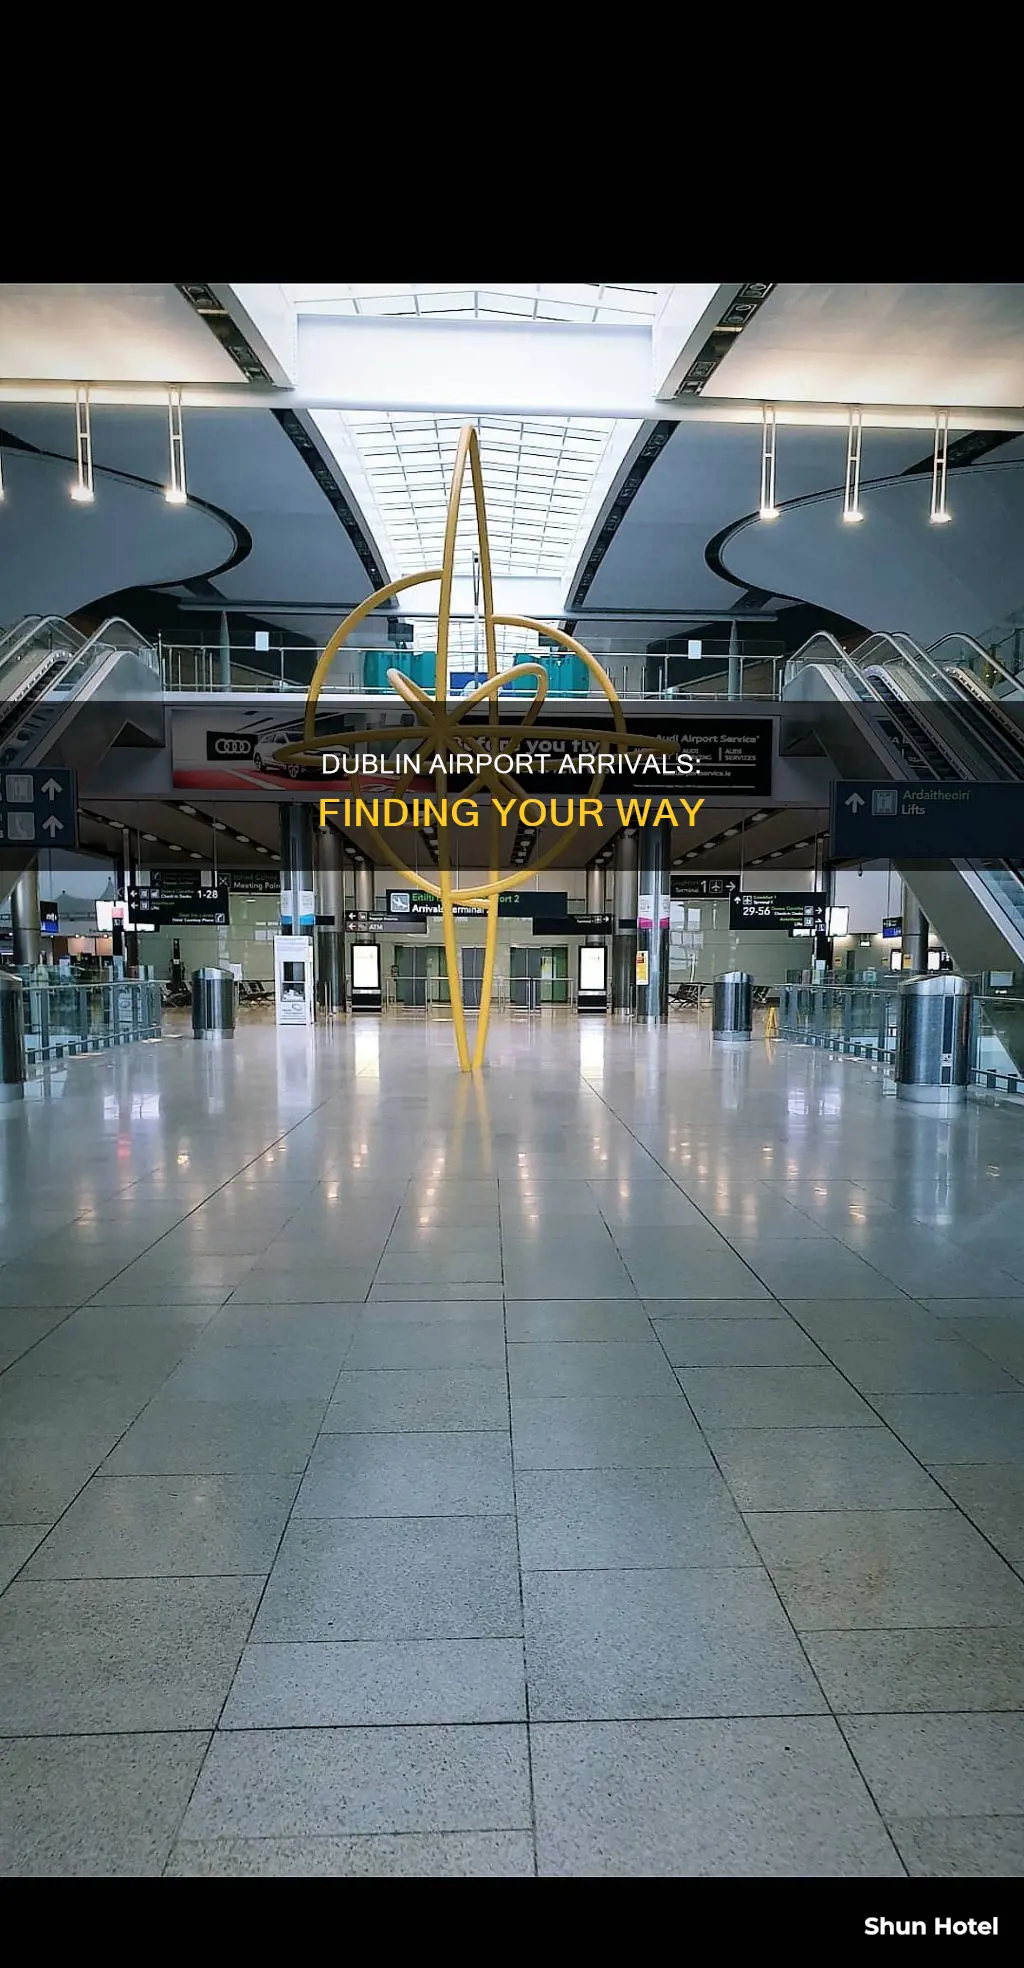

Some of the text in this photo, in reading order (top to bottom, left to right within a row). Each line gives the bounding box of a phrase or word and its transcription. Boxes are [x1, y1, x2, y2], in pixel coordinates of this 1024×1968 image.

[681, 735, 718, 745] Airport
[526, 739, 566, 755] you
[902, 789, 971, 801] Ardaitheoirí
[901, 804, 926, 815] Lifts
[233, 882, 263, 891] Meeting
[700, 880, 707, 893] 1
[197, 889, 219, 899] 1-28
[514, 895, 520, 903] 2
[452, 905, 485, 914] erminal
[743, 906, 771, 916] 29-56
